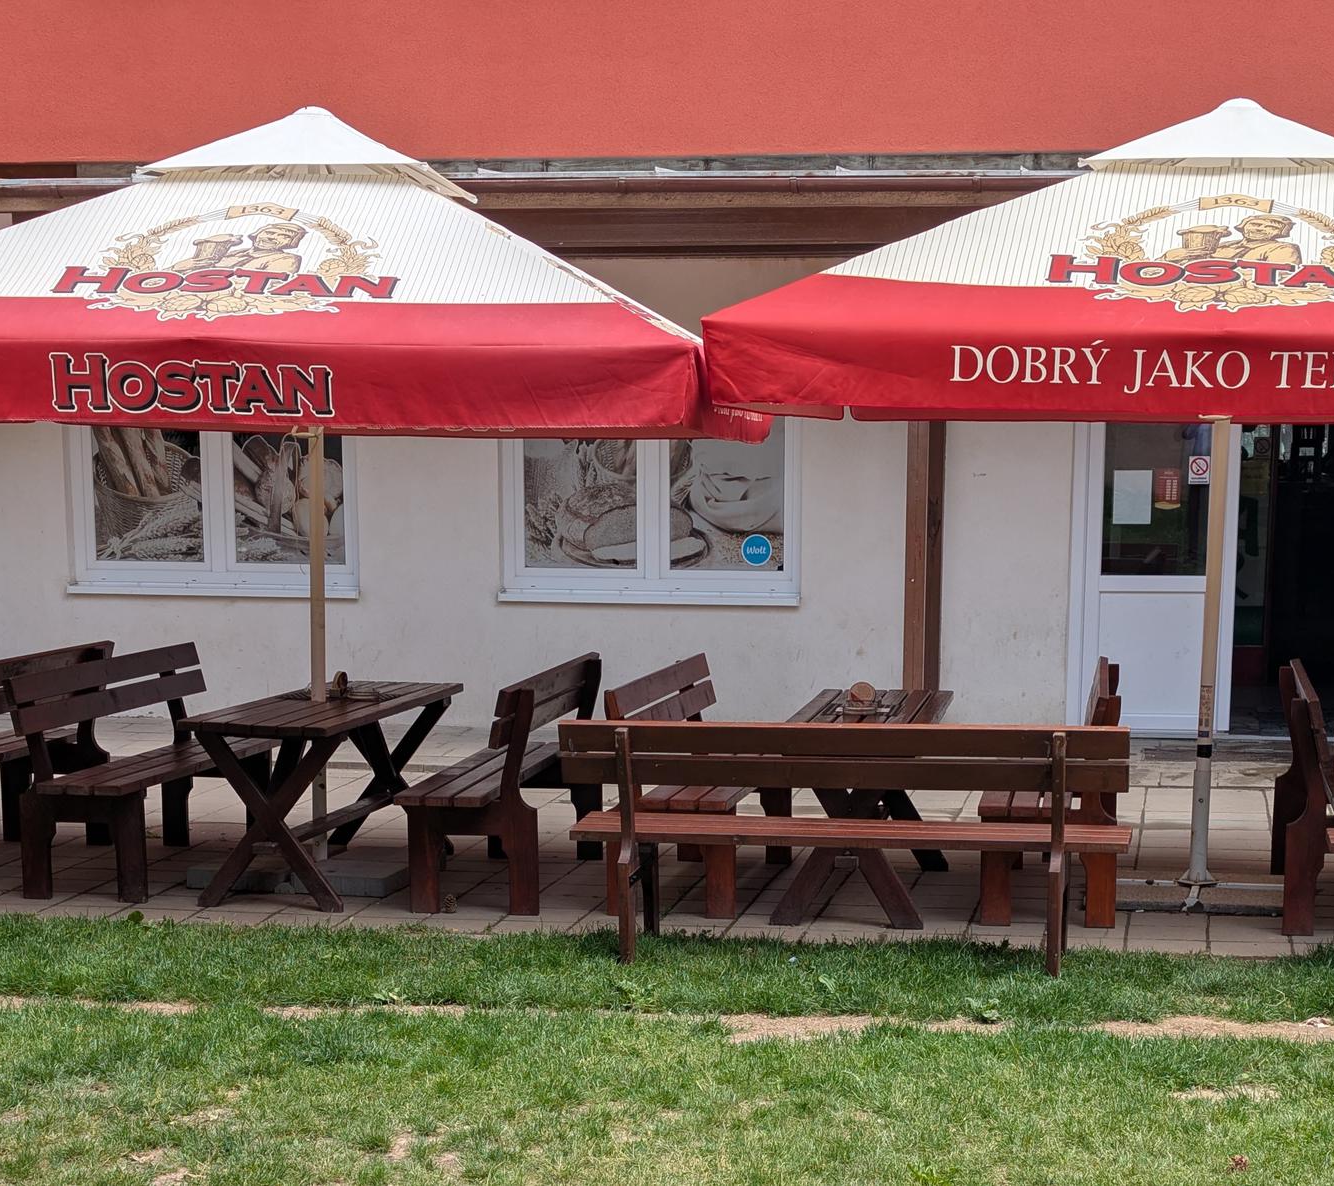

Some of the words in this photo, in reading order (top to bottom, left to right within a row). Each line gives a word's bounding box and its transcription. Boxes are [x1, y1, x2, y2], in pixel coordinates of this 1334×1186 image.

[1213, 195, 1260, 207] 1363
[239, 204, 286, 217] 1363
[949, 340, 1110, 386] DOBRÝ
[1123, 349, 1252, 394] JAKO
[49, 352, 335, 418] HOSTAN
[746, 545, 767, 555] Wolt
